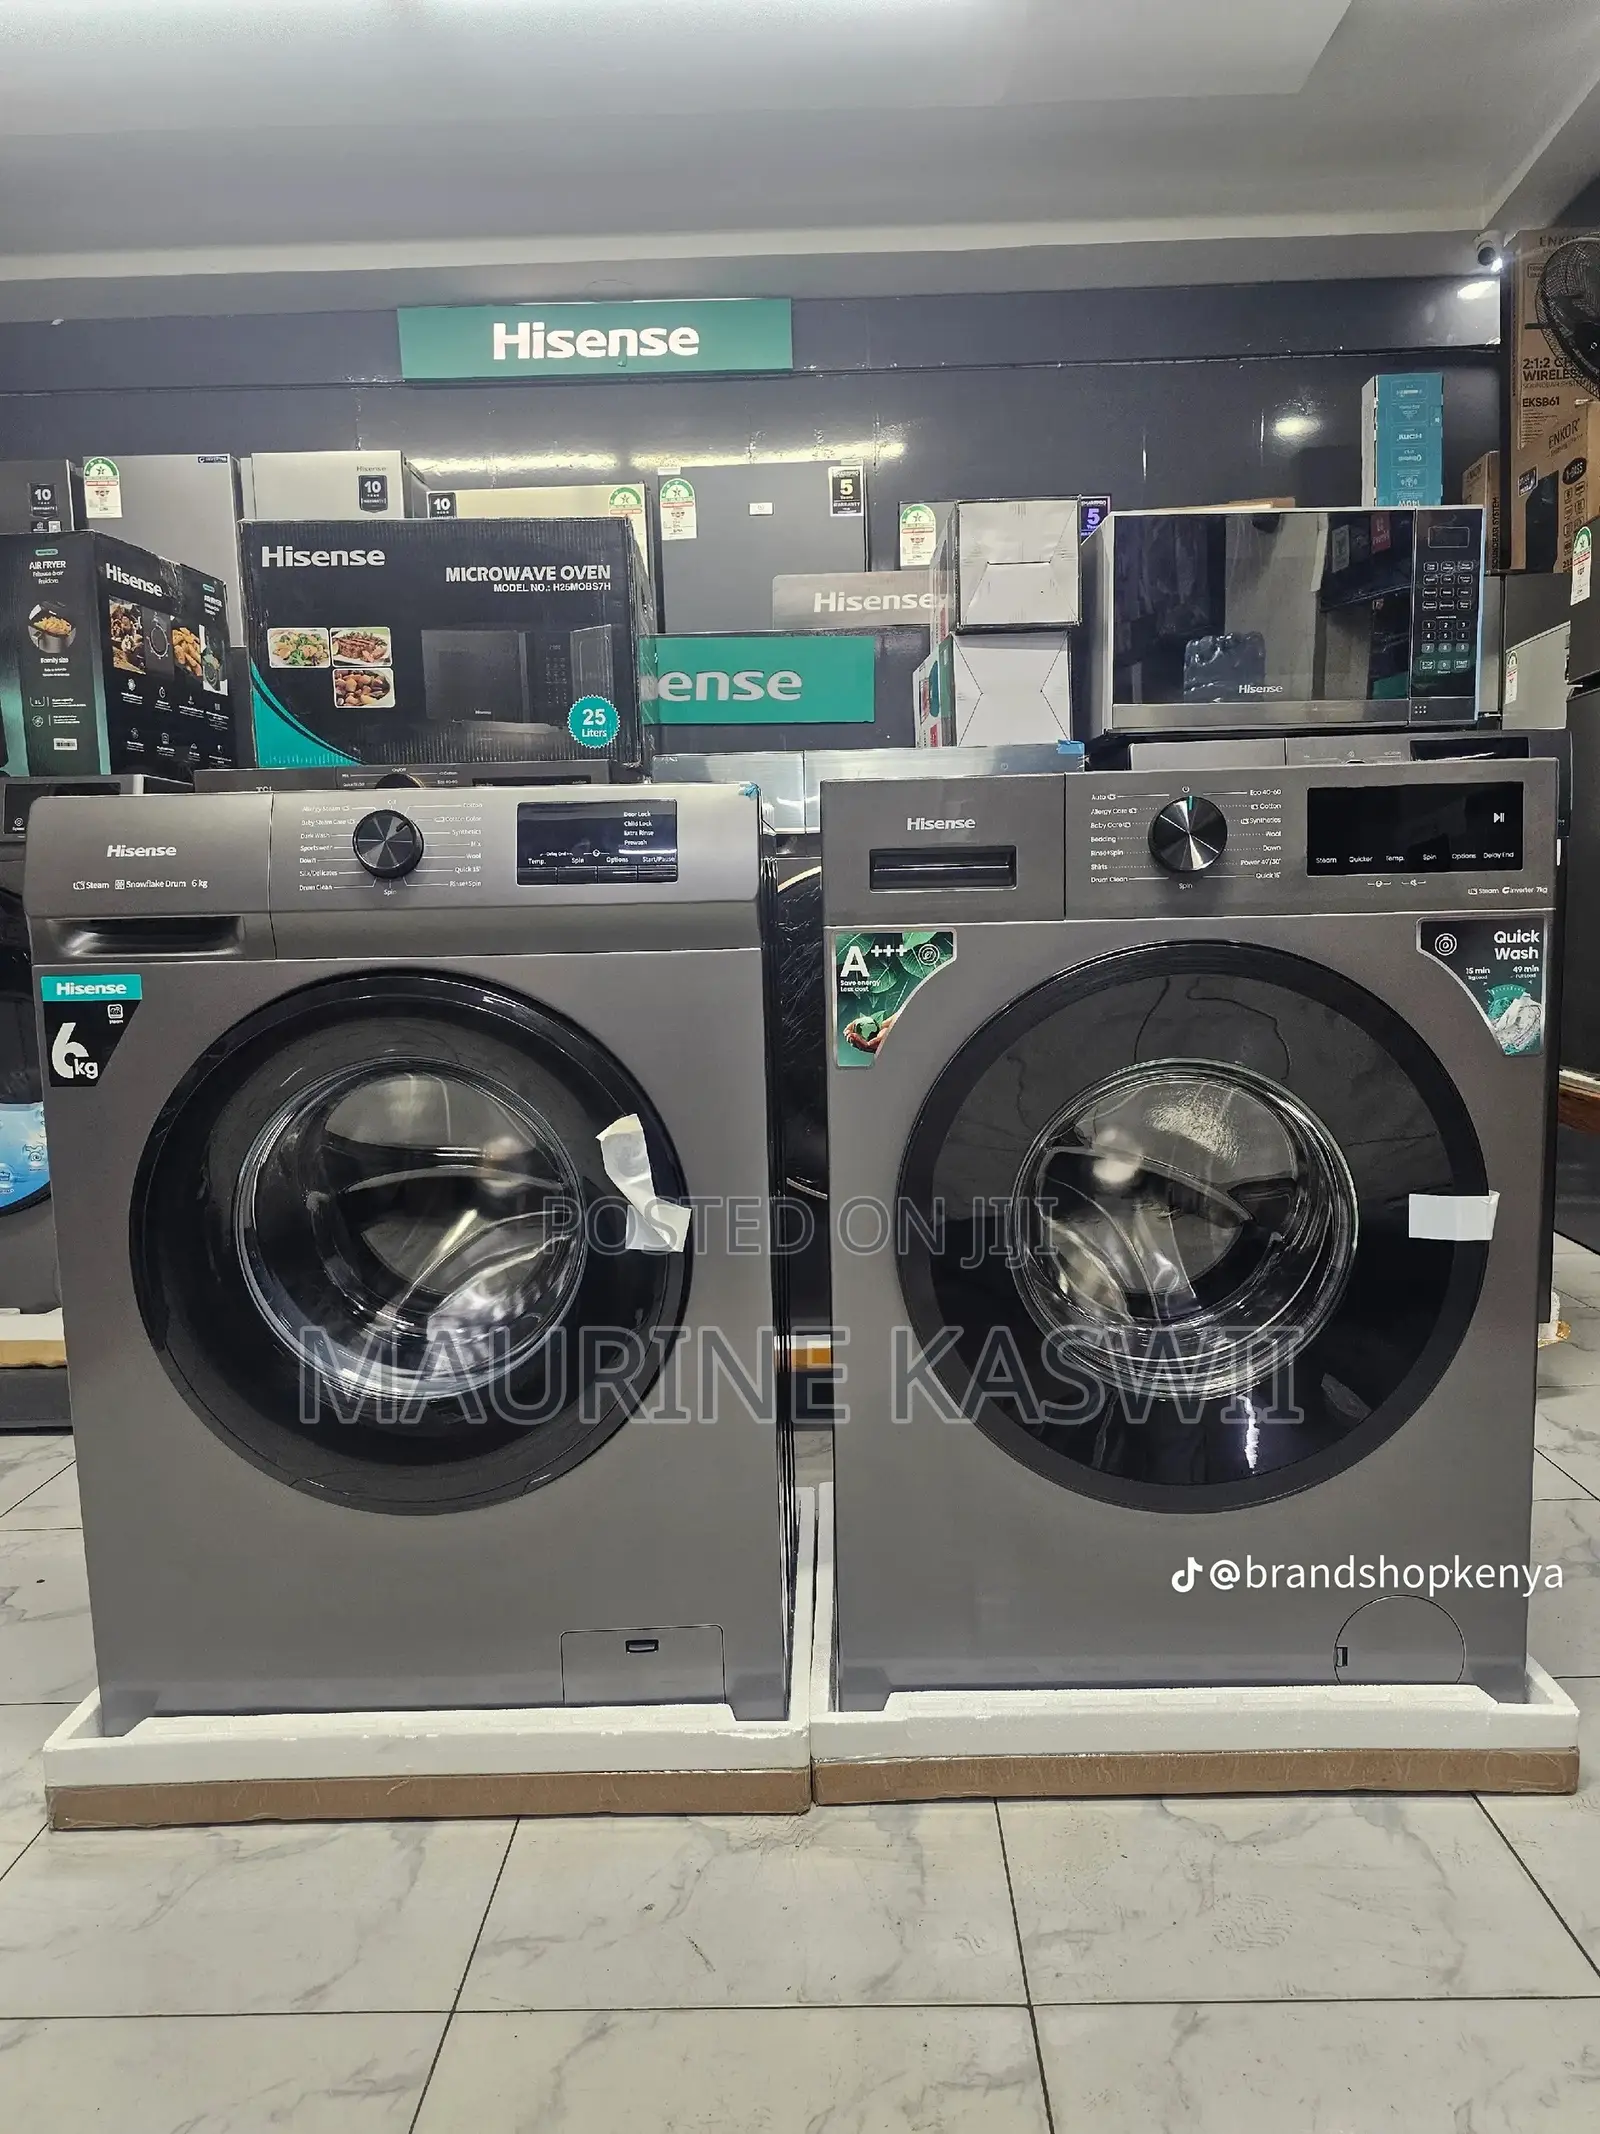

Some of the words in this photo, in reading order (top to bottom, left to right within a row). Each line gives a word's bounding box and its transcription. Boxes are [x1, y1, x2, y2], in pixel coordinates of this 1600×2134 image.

[493, 322, 700, 360] Hisense
[1522, 396, 1560, 408] EKSB61
[364, 480, 382, 494] 10
[839, 479, 854, 496] 5
[34, 488, 52, 501] 10
[433, 498, 451, 510] 10
[1087, 508, 1100, 525] 5
[261, 546, 386, 568] Hisense
[29, 561, 42, 570] AIR
[43, 560, 66, 569] FRYER
[446, 566, 556, 582] MICROWAVE
[560, 565, 611, 581] OVEN
[105, 563, 164, 597] Hisense
[493, 584, 529, 592] MODEL
[531, 583, 551, 592] NO.:
[813, 592, 936, 613] Hisense
[1238, 684, 1283, 694] Hisense
[582, 708, 607, 725] 25
[581, 728, 607, 738] Liters
[1090, 808, 1111, 816] Allergy
[1259, 802, 1282, 810] Cotton
[906, 817, 976, 831] Hisense
[1249, 817, 1282, 825] Synthetics
[452, 828, 482, 836] Synthetics
[106, 844, 177, 858] Hisense
[300, 844, 333, 852] Sportswear
[528, 858, 546, 866] Temp.
[571, 857, 585, 865] Spin
[606, 856, 629, 864] Options
[642, 855, 676, 863] Start/Pause
[1422, 853, 1437, 861] Spin
[1451, 852, 1477, 860] Options
[1483, 851, 1501, 860] Delay
[1501, 851, 1515, 859] End
[86, 881, 110, 889] Steam
[126, 879, 165, 889] Snowflake
[165, 879, 187, 888] Drum
[191, 879, 198, 887] 6
[198, 879, 208, 889] kg
[1178, 882, 1193, 890] Spin
[1536, 886, 1548, 895] 7kg
[1493, 929, 1540, 945] Quick
[1494, 946, 1539, 961] Wash
[1465, 967, 1474, 975] 15
[1474, 966, 1491, 975] min
[1512, 965, 1523, 973] 49
[1523, 964, 1540, 973] min
[56, 982, 127, 996] Hisense
[51, 1022, 99, 1080] 6kg
